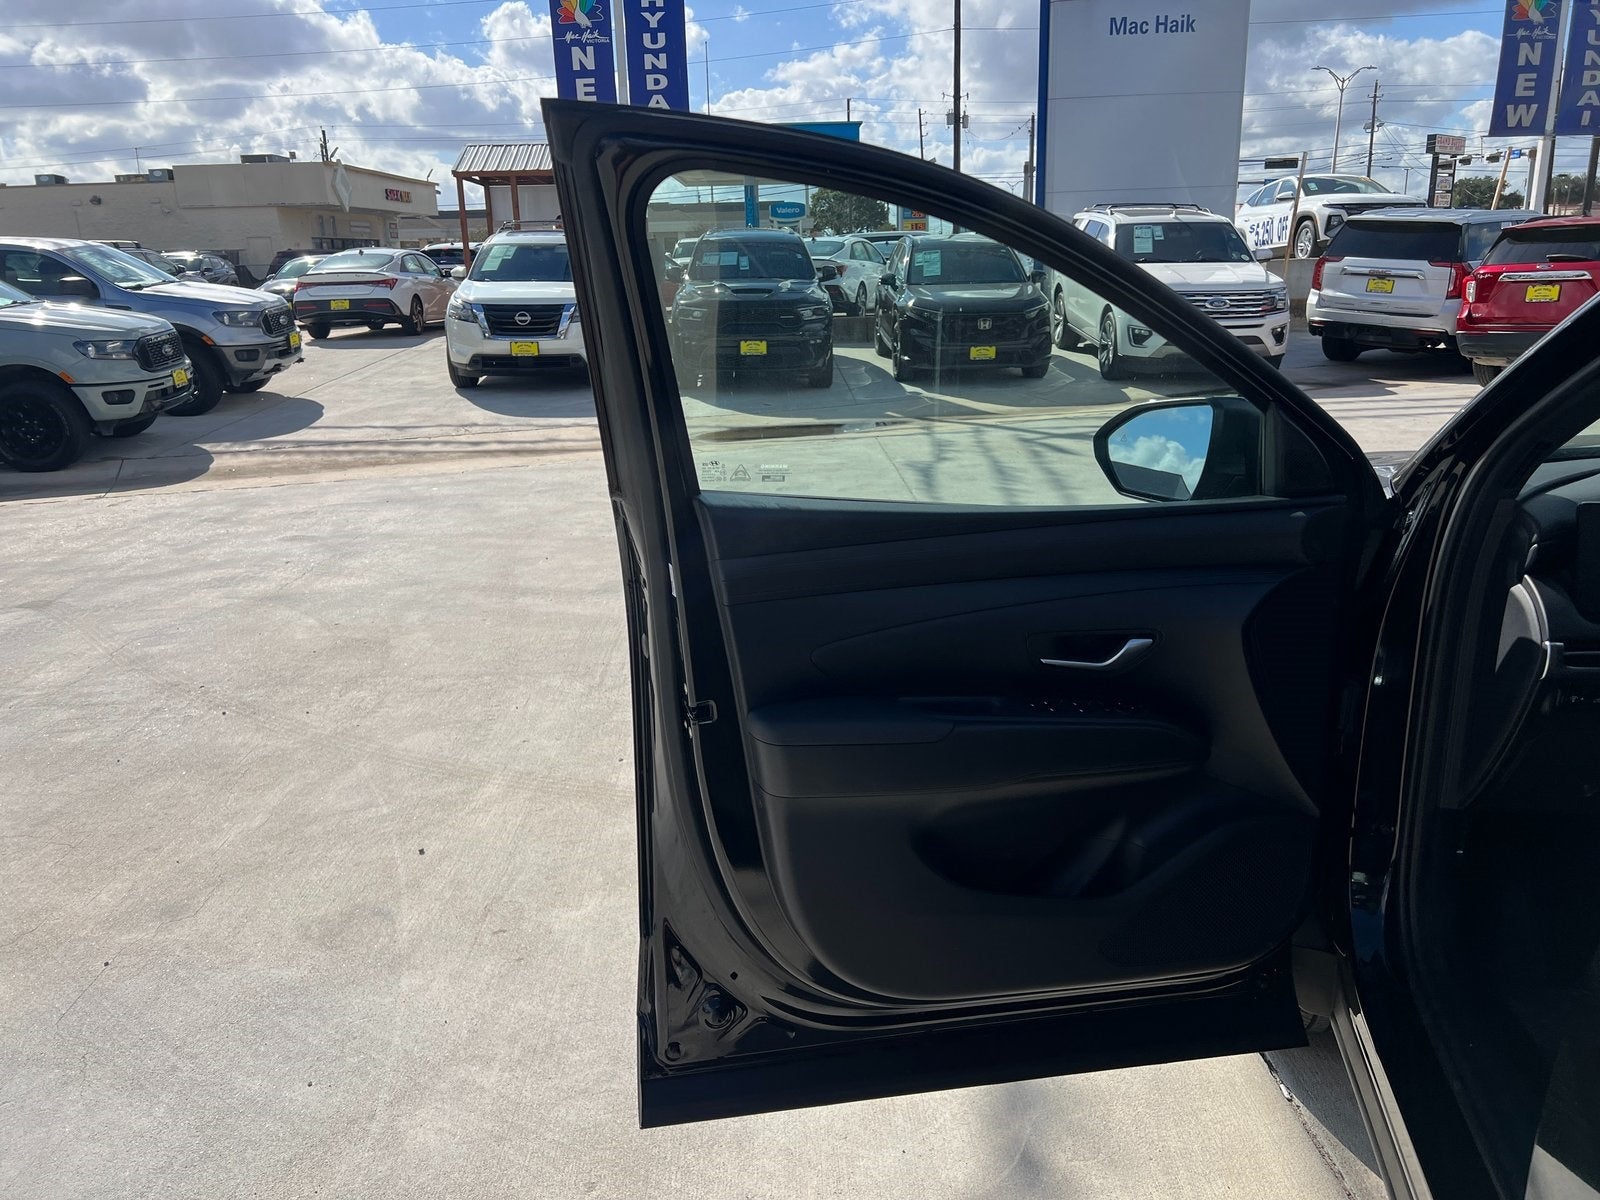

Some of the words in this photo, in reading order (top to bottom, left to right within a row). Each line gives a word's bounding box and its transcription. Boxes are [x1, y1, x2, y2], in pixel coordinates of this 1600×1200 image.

[564, 31, 581, 43] Mac
[582, 29, 603, 43] Haik
[1109, 16, 1149, 36] Mac
[1155, 14, 1196, 34] Haik
[1577, 0, 1600, 126] UNDAI
[1506, 42, 1542, 127] NEW
[1278, 215, 1289, 242] OFF
